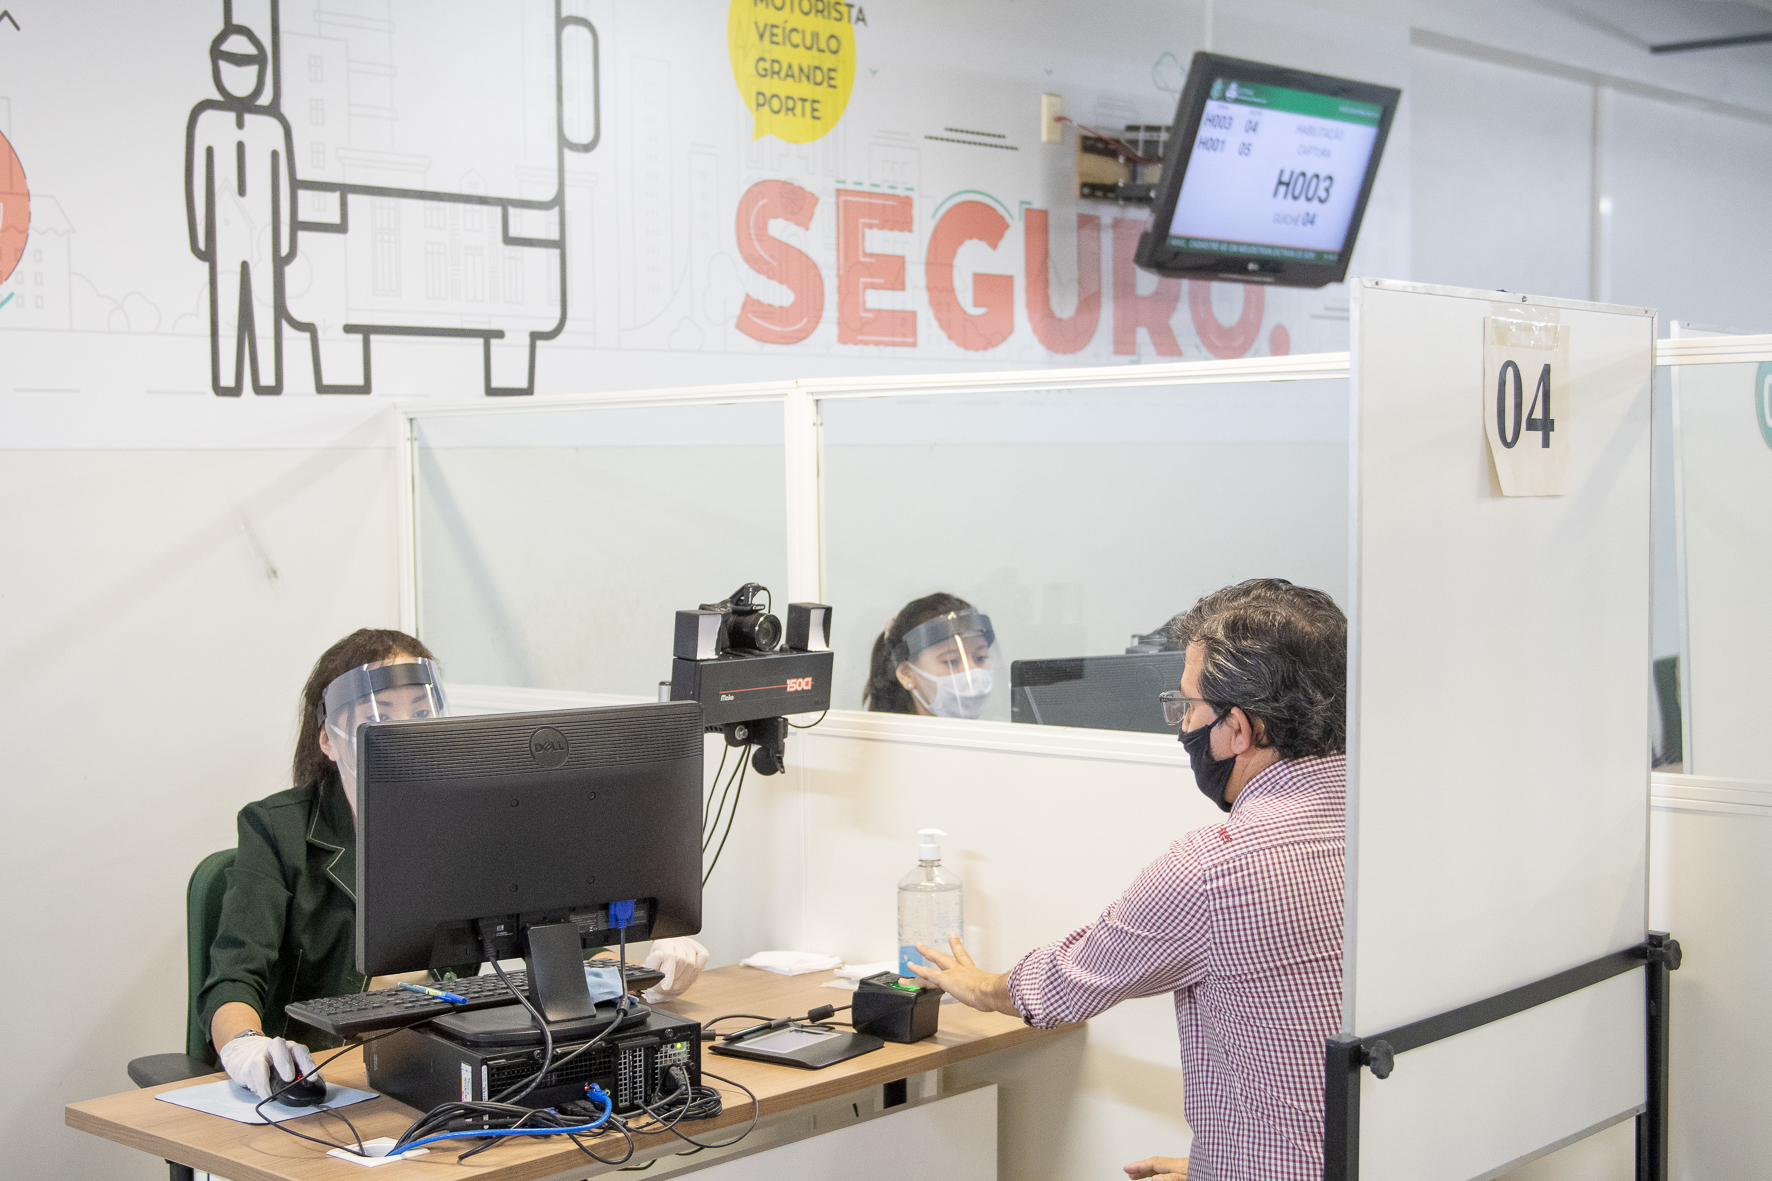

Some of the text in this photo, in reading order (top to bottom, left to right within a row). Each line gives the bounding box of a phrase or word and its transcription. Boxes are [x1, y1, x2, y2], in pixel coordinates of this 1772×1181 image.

[754, 20, 841, 55] VEÍCULO
[754, 56, 838, 89] GRANDE
[755, 91, 822, 120] PORTE
[1203, 112, 1233, 131] H003
[1244, 119, 1259, 134] 04
[1197, 135, 1253, 157] H001 05
[1272, 169, 1334, 204] H003
[1301, 211, 1316, 227] 04
[735, 179, 1290, 360] SEGURO.
[1496, 359, 1555, 449] 04
[534, 742, 565, 753] DELL
